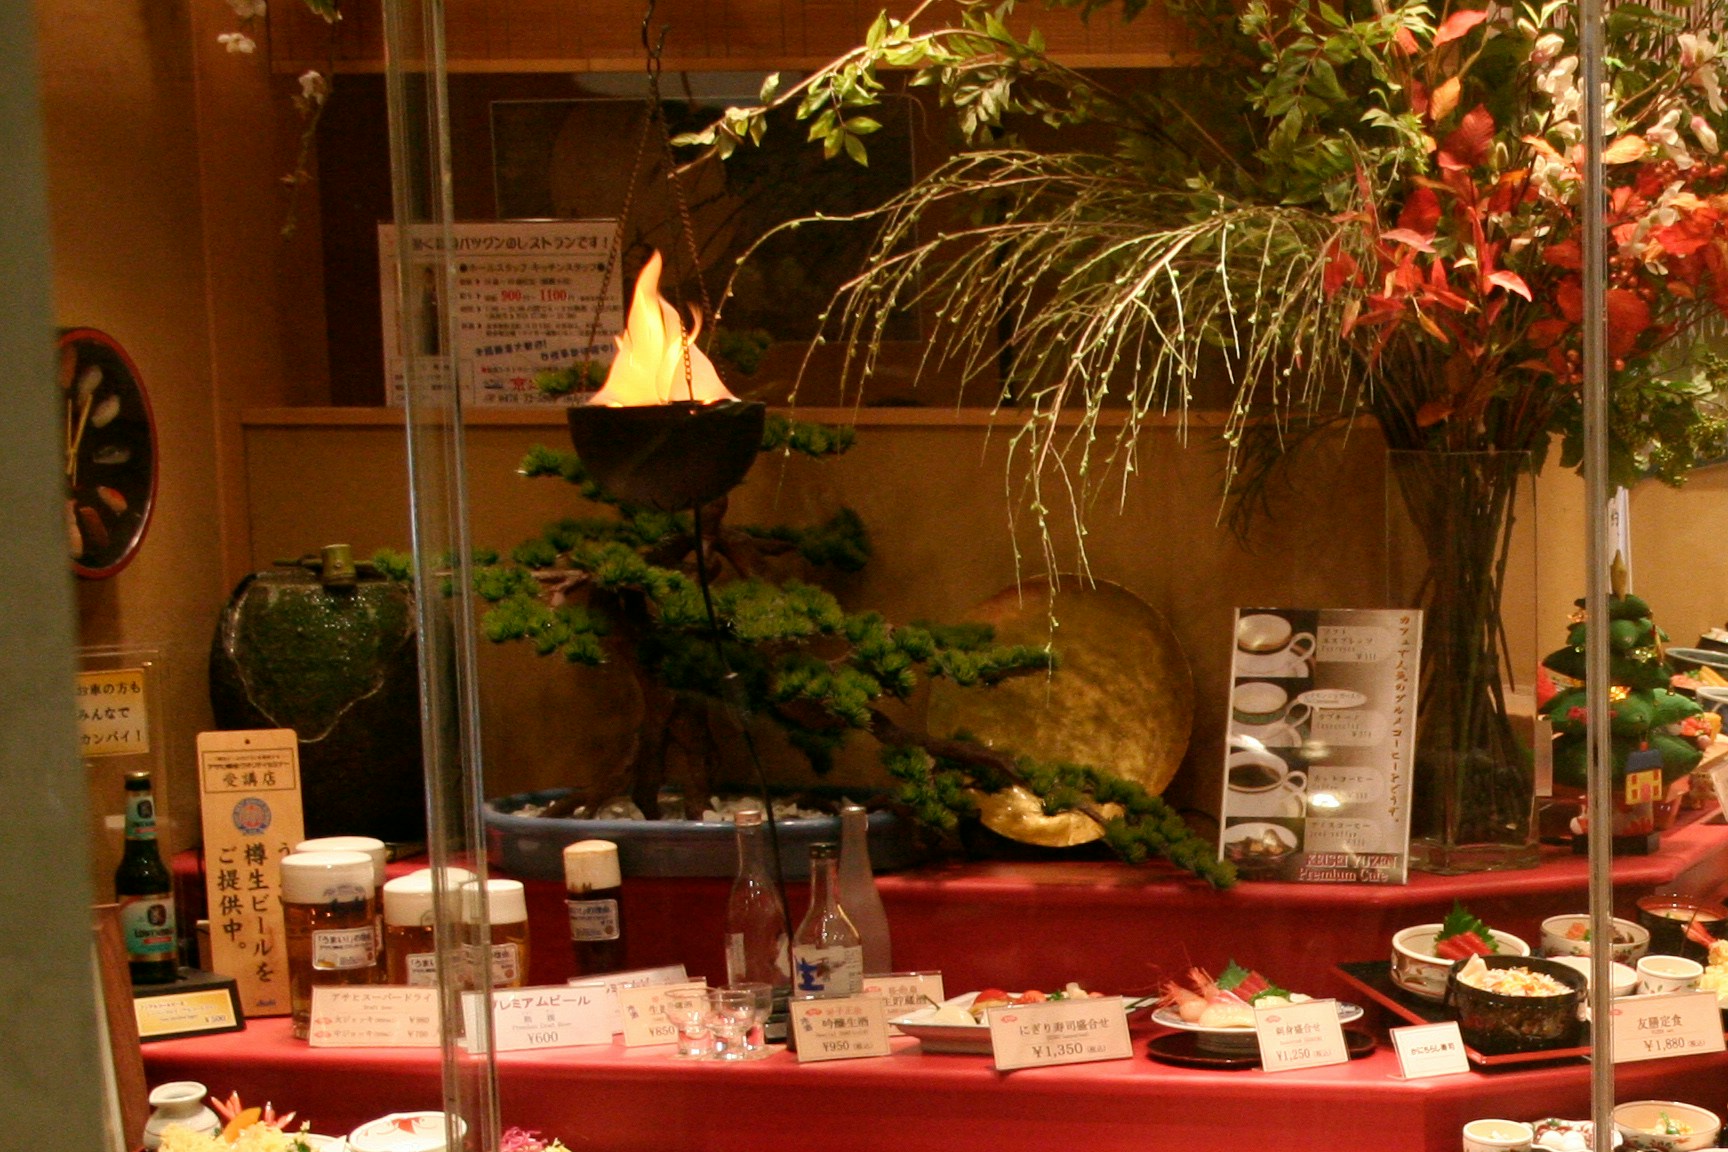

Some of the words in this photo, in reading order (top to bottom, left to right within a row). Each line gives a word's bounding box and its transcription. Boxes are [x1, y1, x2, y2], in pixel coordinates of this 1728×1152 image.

[217, 846, 248, 951] ご提供中。
[244, 842, 276, 984] 樽生ビールを
[1019, 1017, 1111, 1036] にぎり寿司盛合せ
[1637, 1013, 1684, 1030] 友膳定食
[528, 1030, 559, 1046] ¥600
[1031, 1042, 1083, 1059] ¥1,350
[1275, 1047, 1311, 1062] ¥1,250
